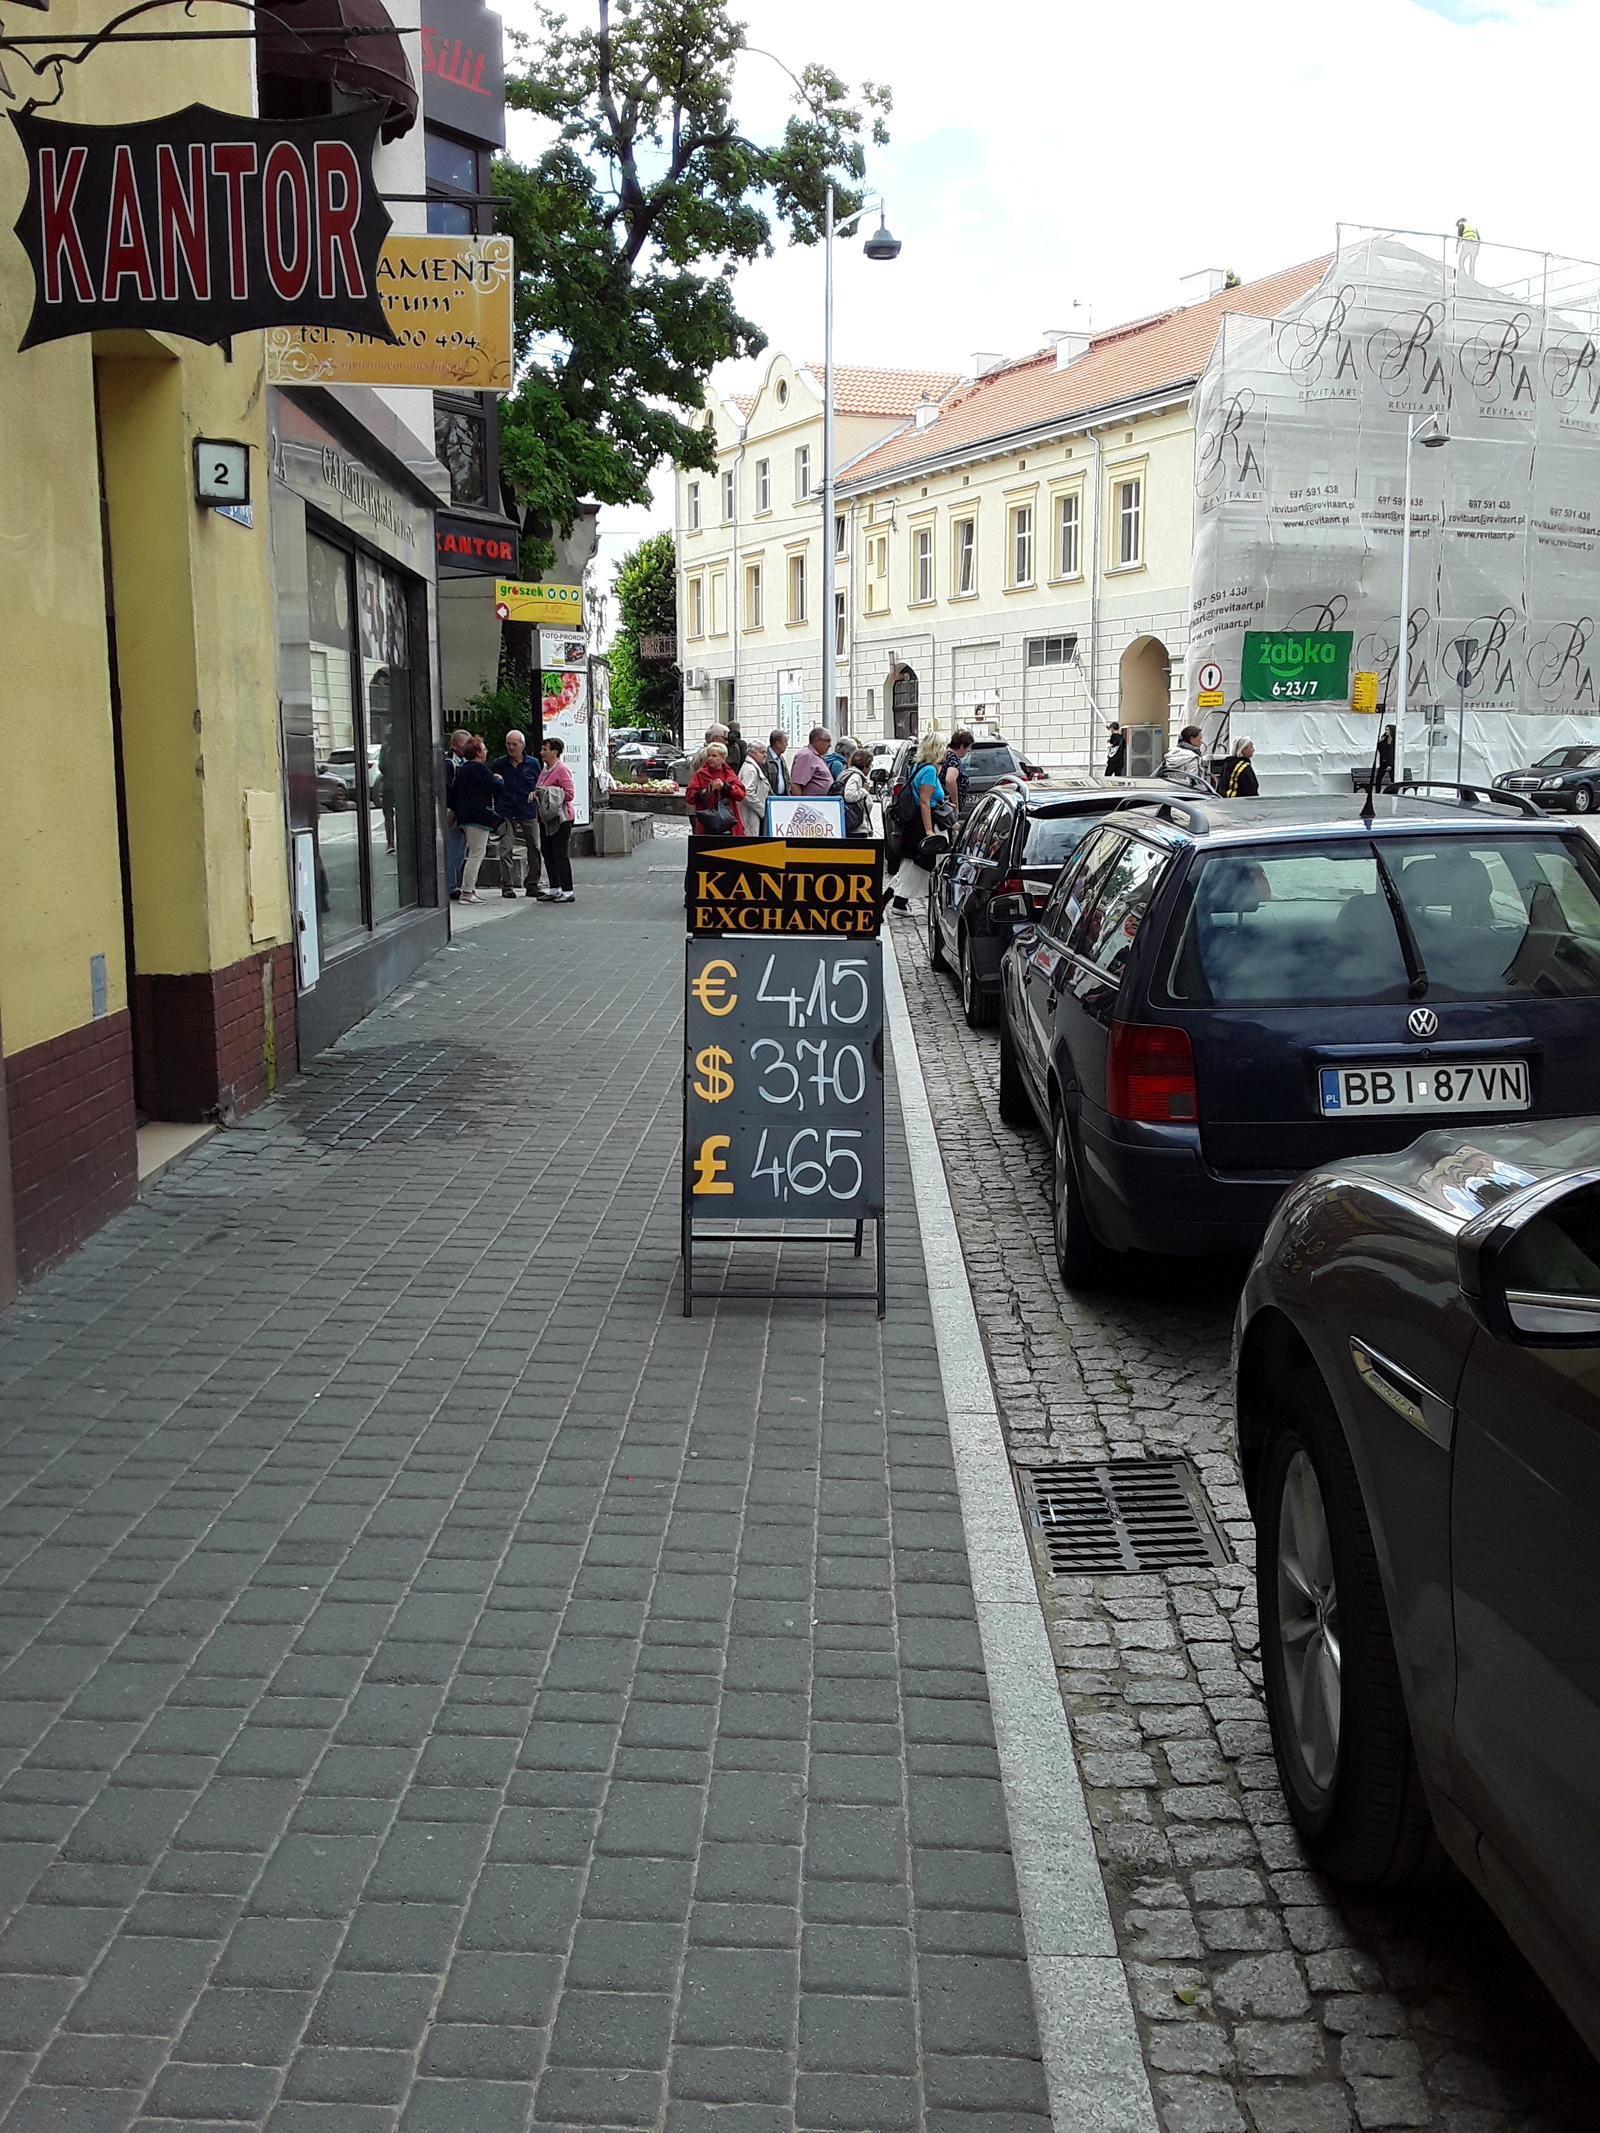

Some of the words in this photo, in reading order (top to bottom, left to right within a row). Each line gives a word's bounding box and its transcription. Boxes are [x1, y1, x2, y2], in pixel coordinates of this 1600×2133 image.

[421, 25, 492, 96] Silit
[39, 140, 368, 304] KANTOR
[383, 328, 427, 348] 00
[434, 329, 479, 351] 494
[214, 463, 229, 485] 2
[321, 444, 368, 512] GALERIA
[1289, 489, 1303, 499] 697
[1306, 487, 1321, 498] 591
[1323, 485, 1339, 495] 438
[1377, 496, 1390, 505] 697
[1468, 499, 1482, 509] 697
[1483, 500, 1496, 509] 591
[1498, 500, 1511, 510] 438
[1283, 515, 1350, 529] www.revitaart.pl
[1456, 530, 1516, 542] www.revitaart.pl
[500, 585, 544, 598] groszek
[1210, 590, 1226, 603] 591
[1258, 637, 1336, 665] żabka
[1272, 681, 1319, 696] 6-23/7
[775, 823, 835, 837] KANTOR
[696, 871, 876, 903] KANTOR
[694, 907, 875, 933] EXCHANGE
[691, 959, 738, 1017] €
[756, 953, 869, 1028] 4,15
[693, 1045, 735, 1104] $
[750, 1038, 866, 1112] 3,70
[1326, 1094, 1338, 1104] PL
[692, 1134, 735, 1195] £
[750, 1127, 863, 1203] 4,65
